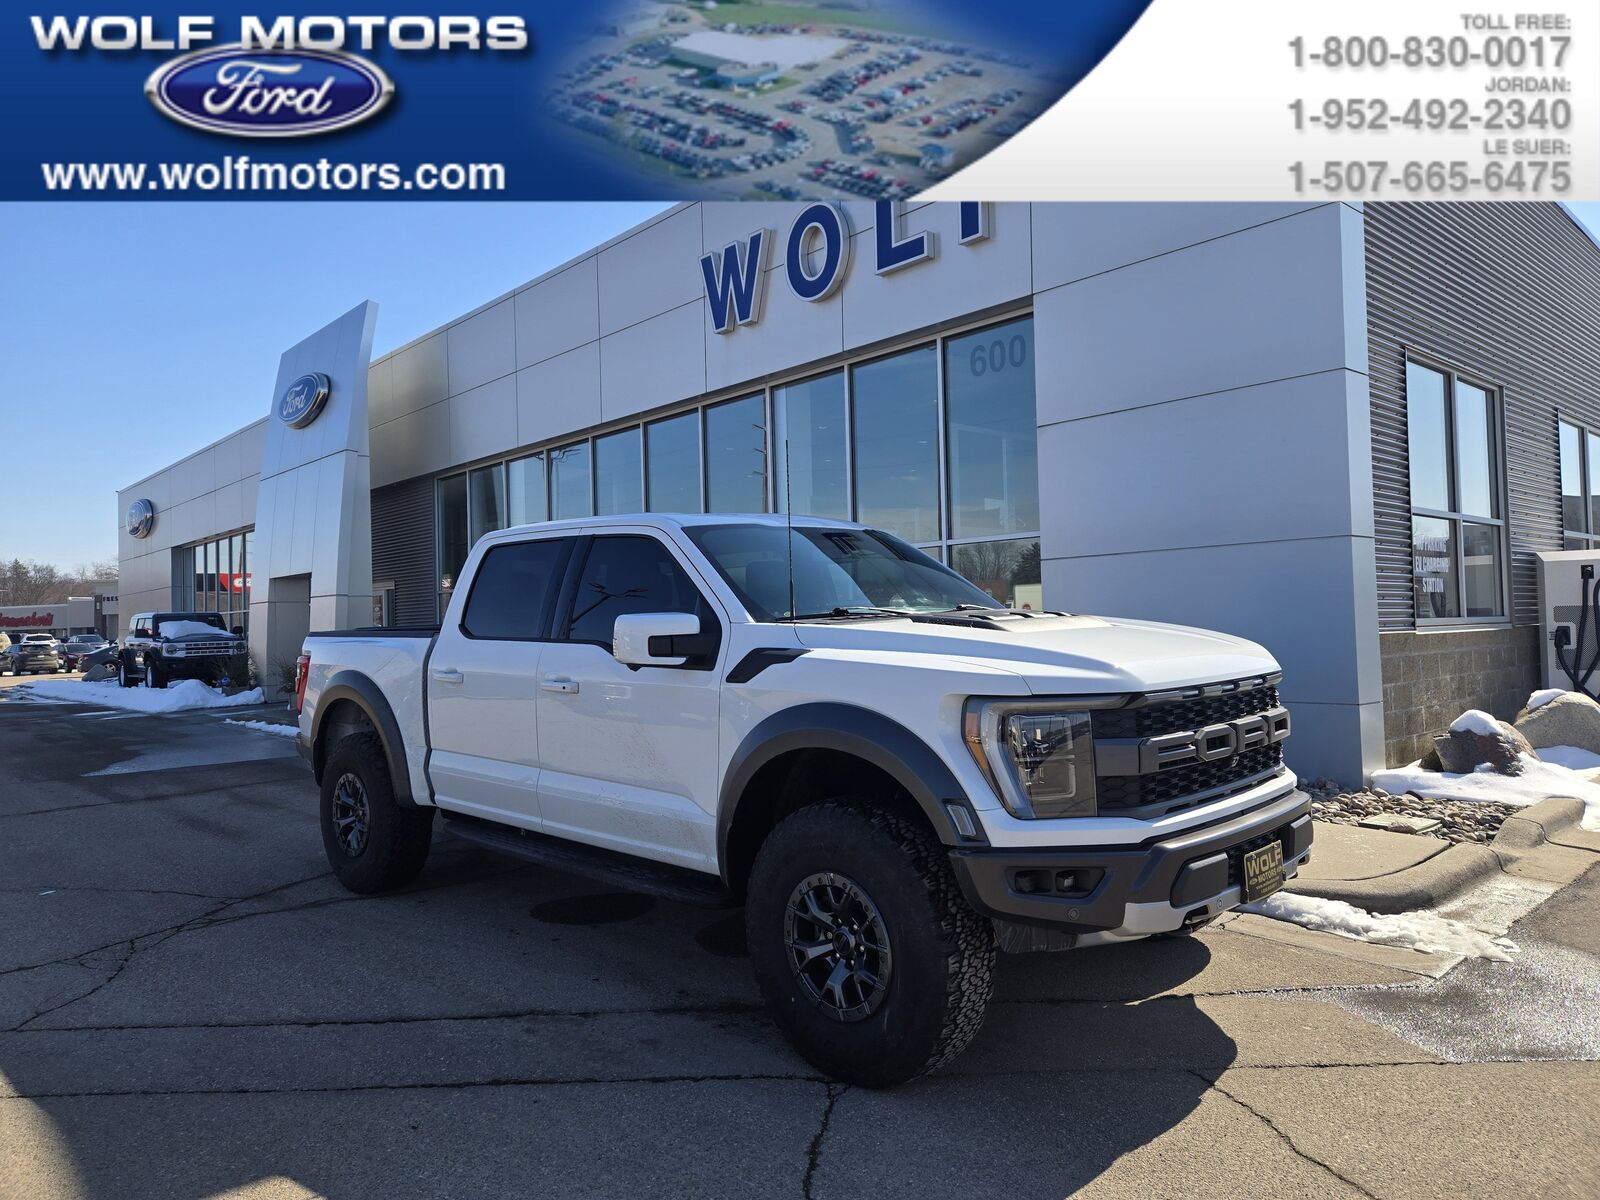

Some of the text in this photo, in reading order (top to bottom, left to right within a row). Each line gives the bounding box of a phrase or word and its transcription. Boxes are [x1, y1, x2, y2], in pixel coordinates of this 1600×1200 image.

[971, 335, 1026, 376] 600
[283, 384, 308, 416] Ford
[1422, 578, 1443, 592] STATION
[1139, 706, 1291, 773] FORD
[1247, 848, 1281, 877] WOLF
[1257, 868, 1277, 883] MOTORS
